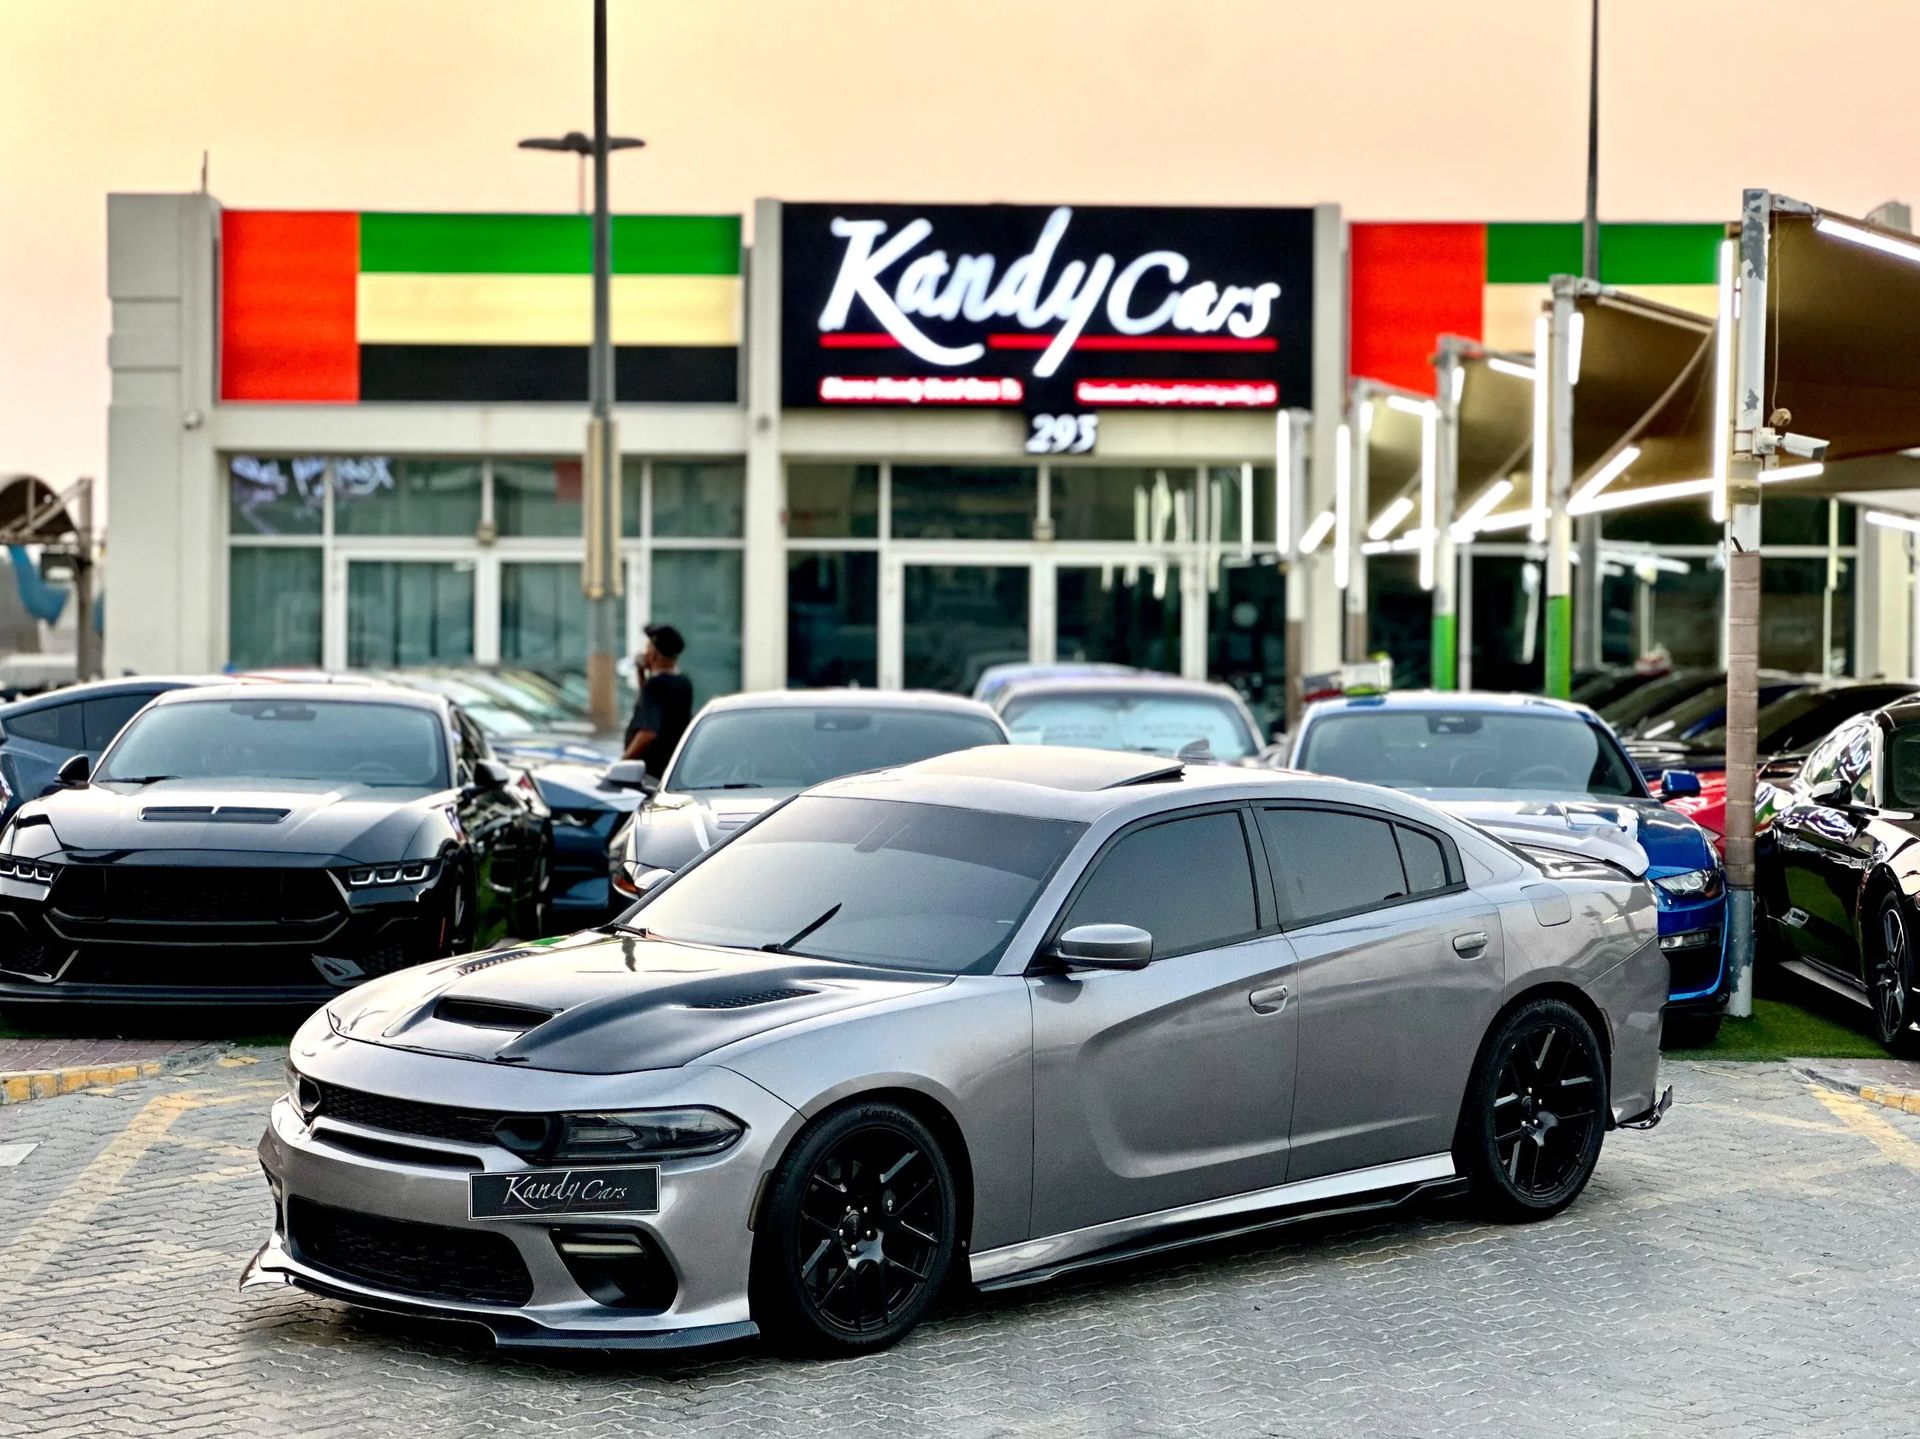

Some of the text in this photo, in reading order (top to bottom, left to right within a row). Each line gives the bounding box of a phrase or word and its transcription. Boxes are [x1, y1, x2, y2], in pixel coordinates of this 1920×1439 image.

[817, 206, 1282, 378] Kandy Cars
[1024, 413, 1099, 454] 295
[502, 1171, 628, 1212] Kandy Cars
